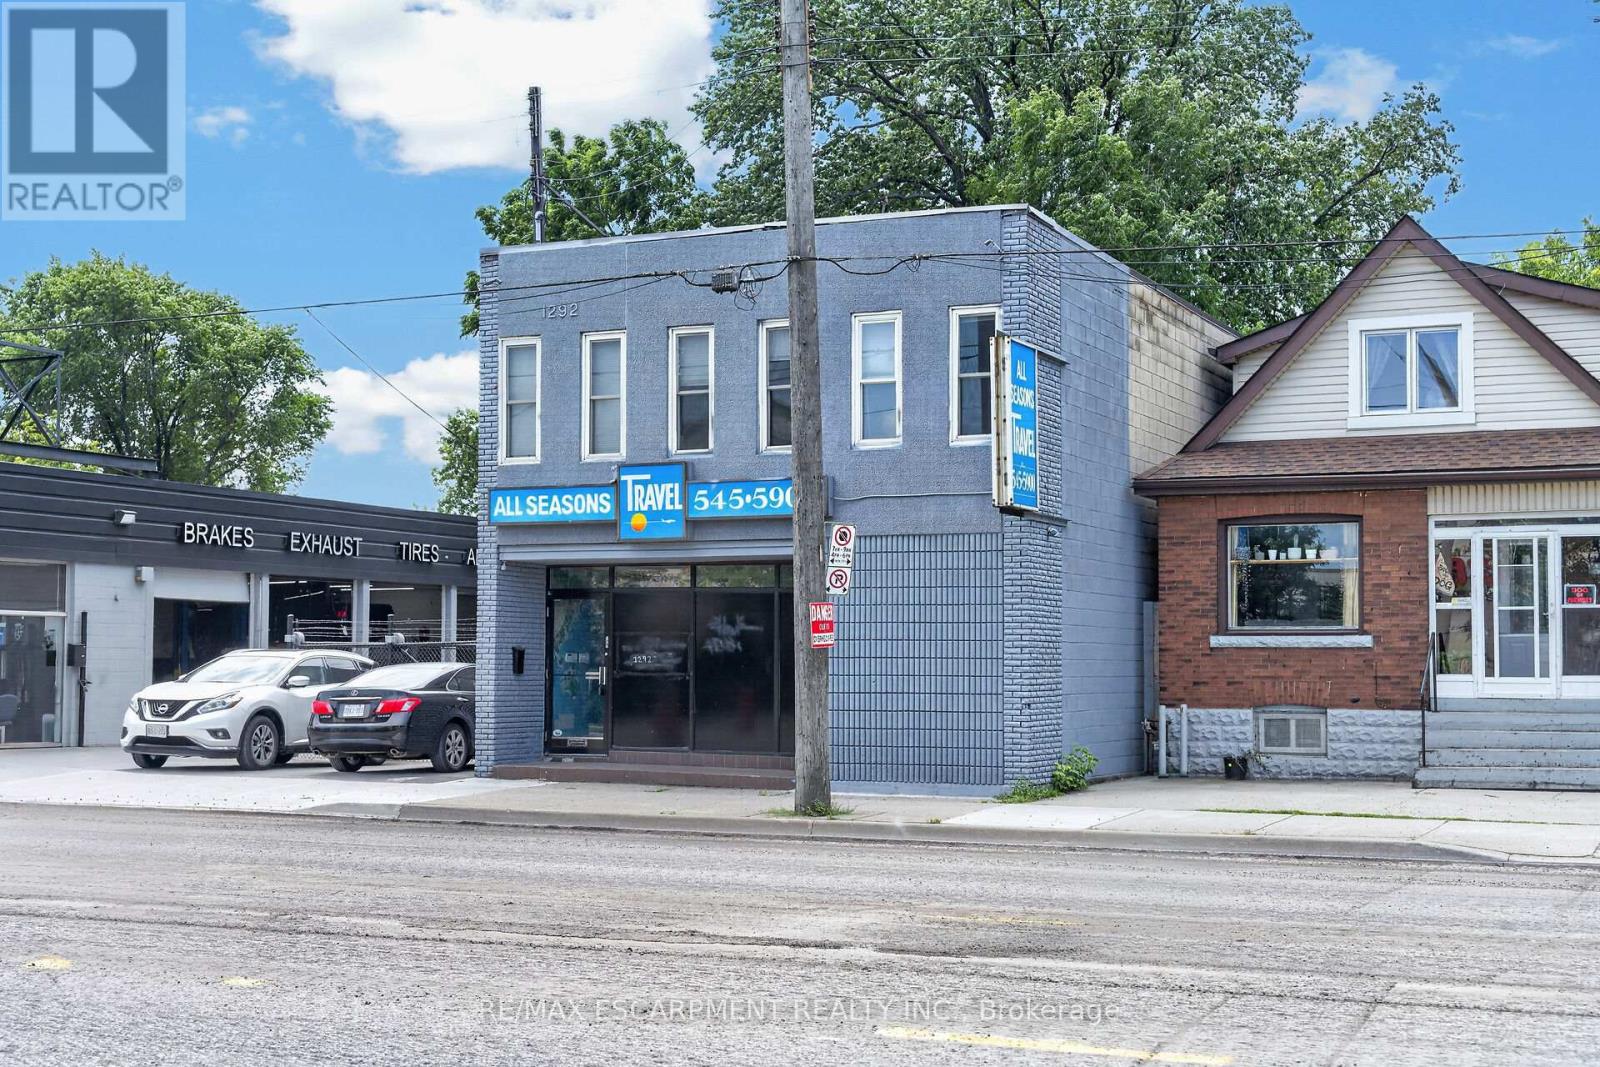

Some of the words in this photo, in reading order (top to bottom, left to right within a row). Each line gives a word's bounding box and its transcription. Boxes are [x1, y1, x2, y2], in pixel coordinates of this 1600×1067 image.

[542, 303, 579, 319] 1292
[1016, 359, 1028, 381] ALL
[1010, 383, 1036, 409] SEASONS
[1011, 413, 1036, 458] TRAVEL
[493, 495, 524, 517] ALL
[526, 492, 612, 515] SEASONS
[620, 474, 683, 512] TRAVEL
[183, 522, 255, 548] BRAKES
[290, 531, 364, 557] EXHAUST
[400, 541, 440, 563] TIRES
